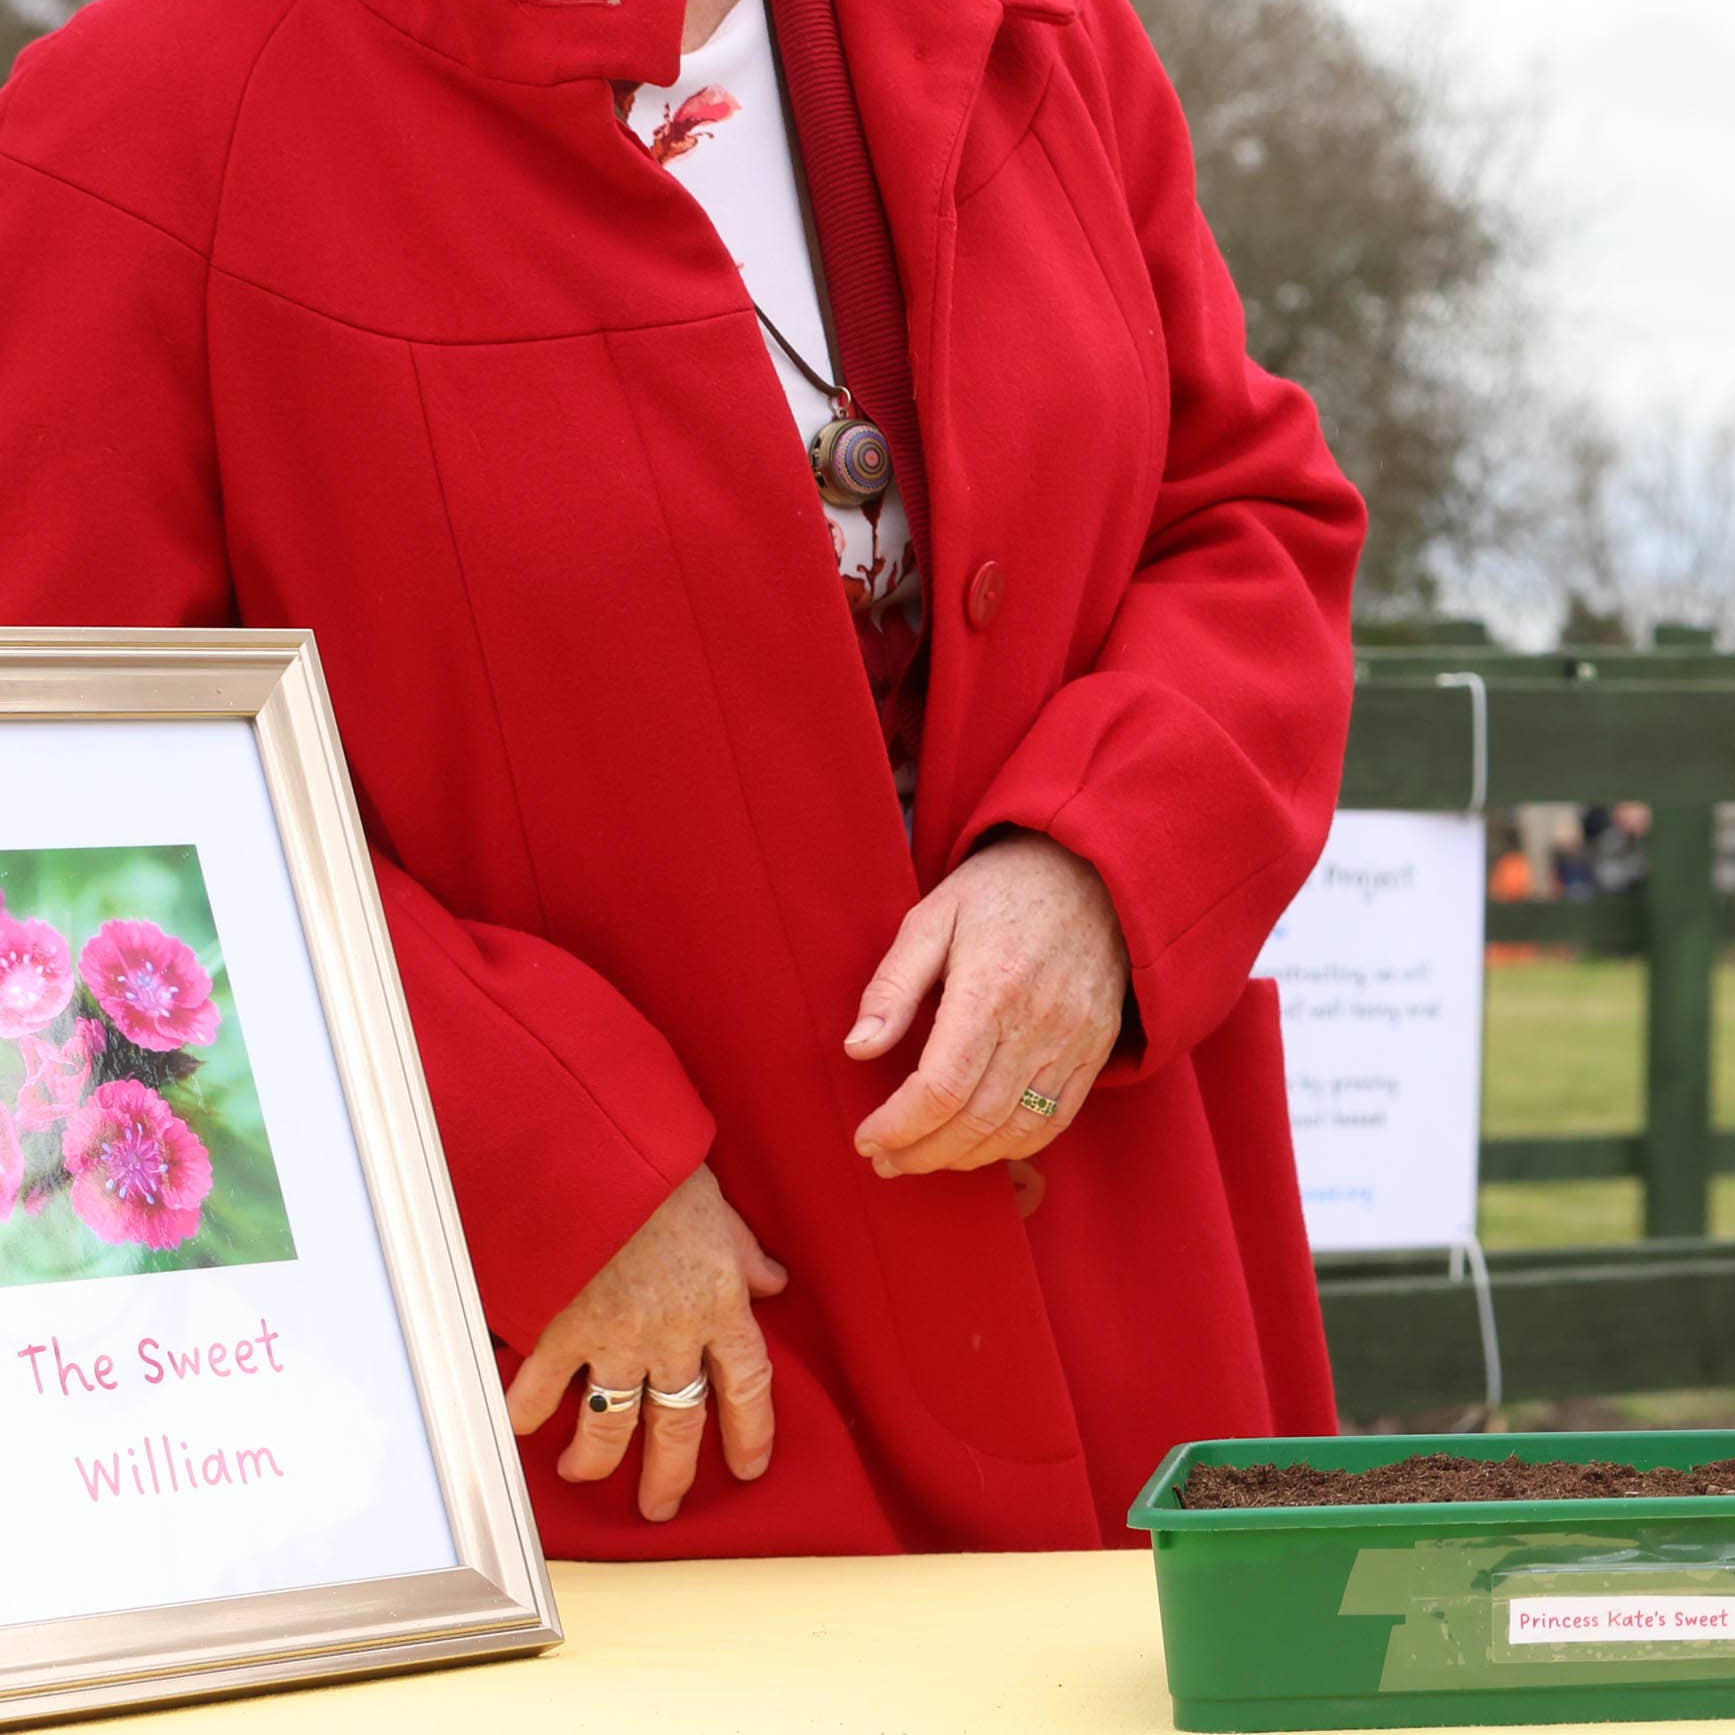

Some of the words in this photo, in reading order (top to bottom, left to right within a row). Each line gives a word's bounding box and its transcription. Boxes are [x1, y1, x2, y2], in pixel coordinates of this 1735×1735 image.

[1321, 861, 1416, 906] Project
[18, 1337, 118, 1395] The
[137, 1319, 284, 1385] Sweet
[74, 1434, 284, 1501] William
[1518, 1610, 1600, 1629] Princess
[1608, 1610, 1667, 1628] Kate's
[1675, 1609, 1729, 1628] Sweet
